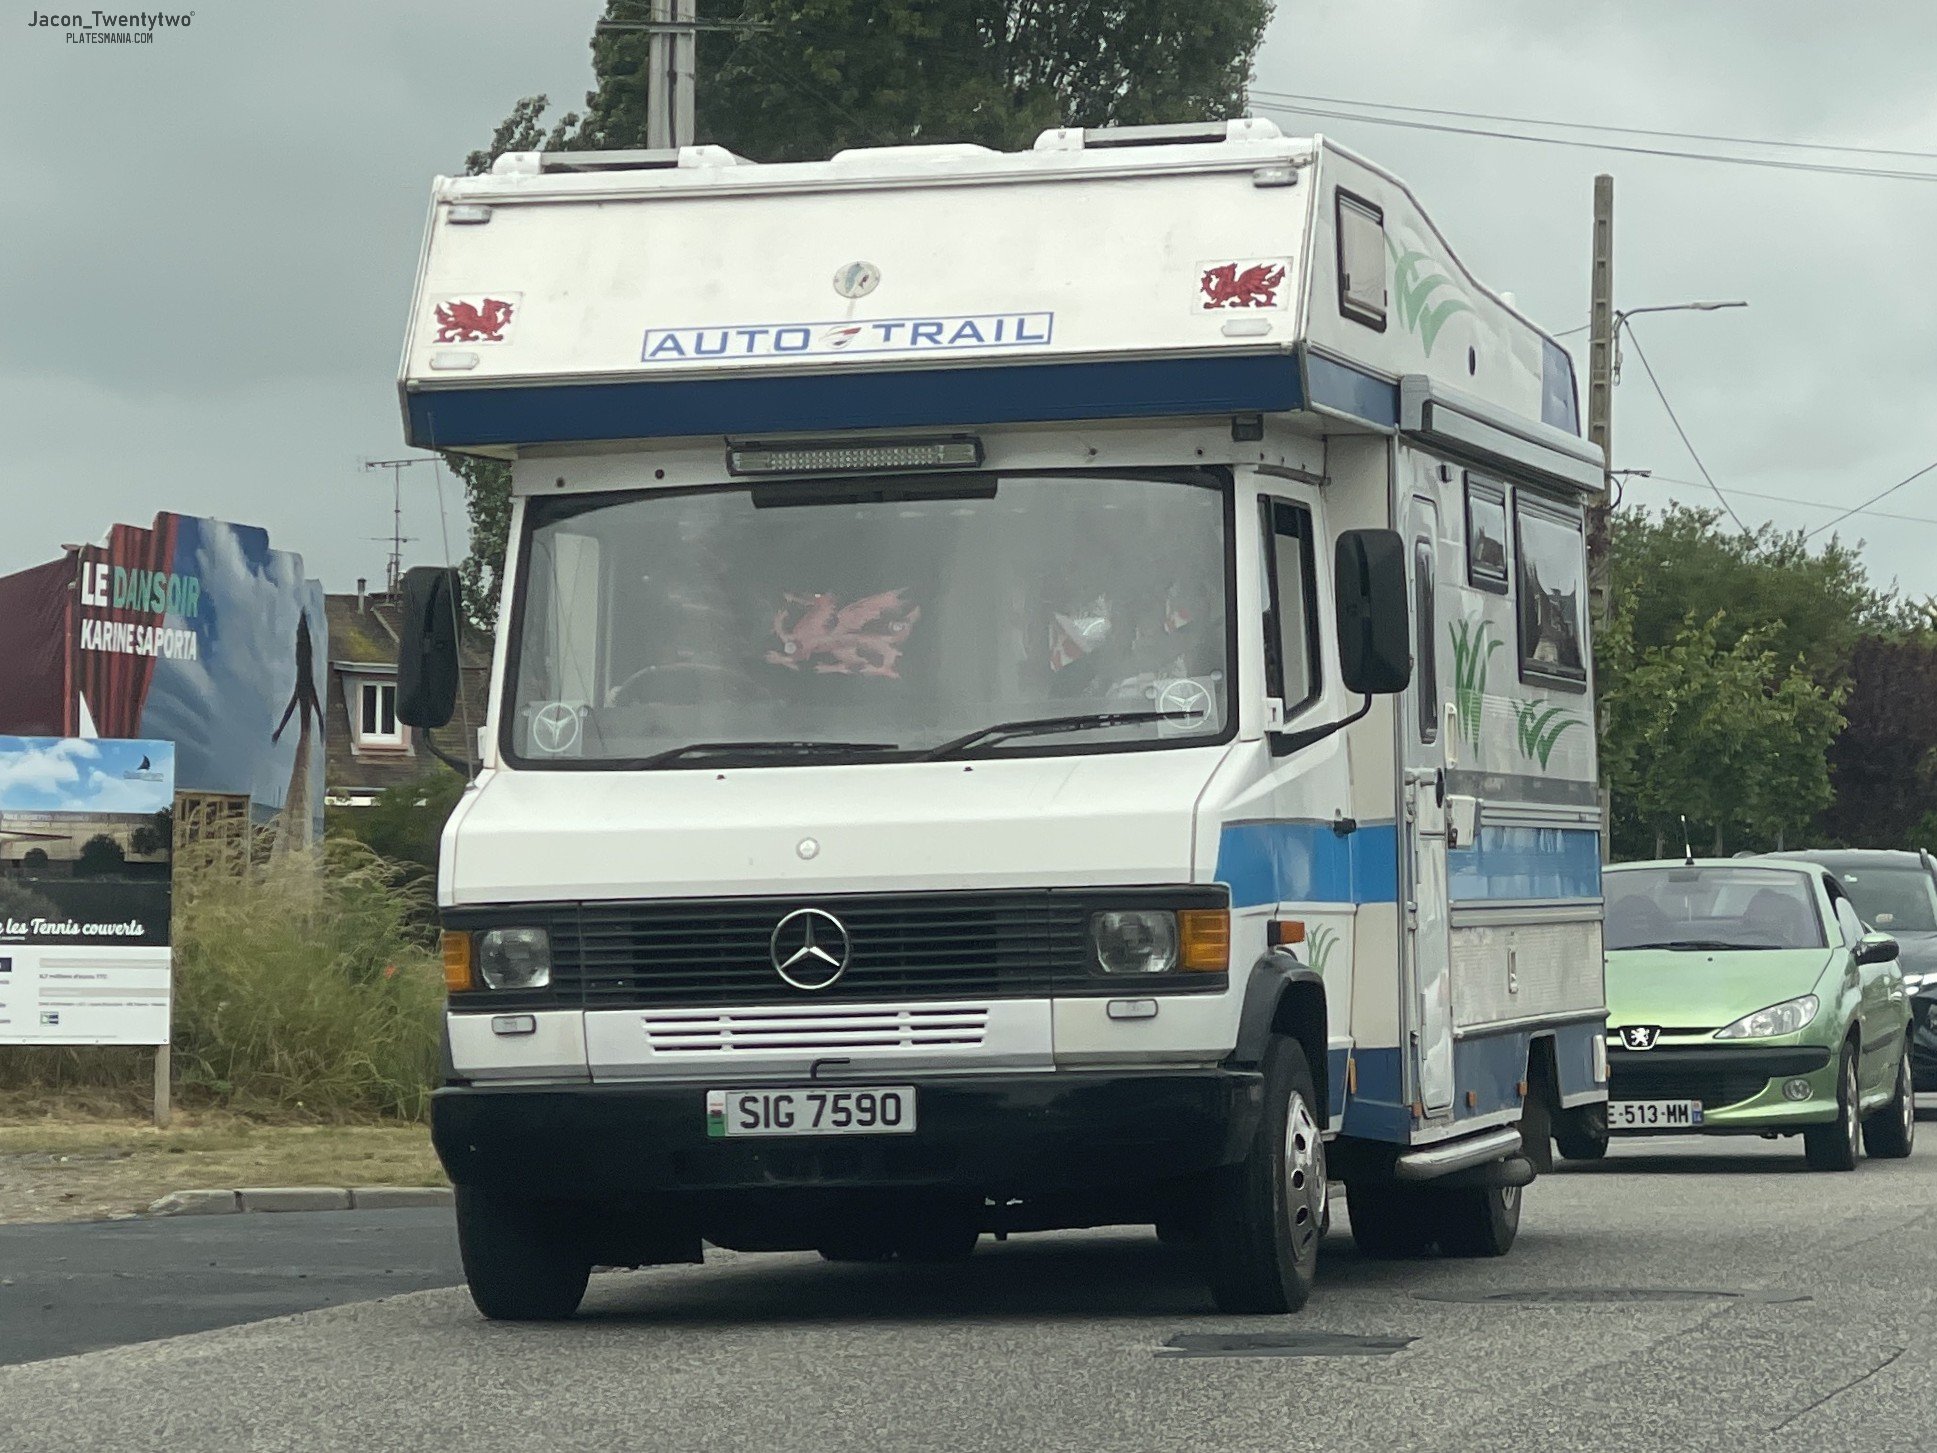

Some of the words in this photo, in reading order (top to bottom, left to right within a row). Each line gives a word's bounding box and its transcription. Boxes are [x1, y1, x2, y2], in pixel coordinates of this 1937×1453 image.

[649, 327, 811, 358] AUTO
[872, 317, 1046, 346] TRAIL
[81, 561, 109, 607] LE
[113, 566, 200, 618] DANSOIR
[80, 618, 135, 655] KARINE
[136, 625, 197, 661] SAPORTA
[6, 917, 28, 936] les
[30, 918, 81, 936] Tennis
[81, 919, 145, 937] couverts
[738, 1094, 795, 1129] SIG
[806, 1092, 901, 1128] 7590
